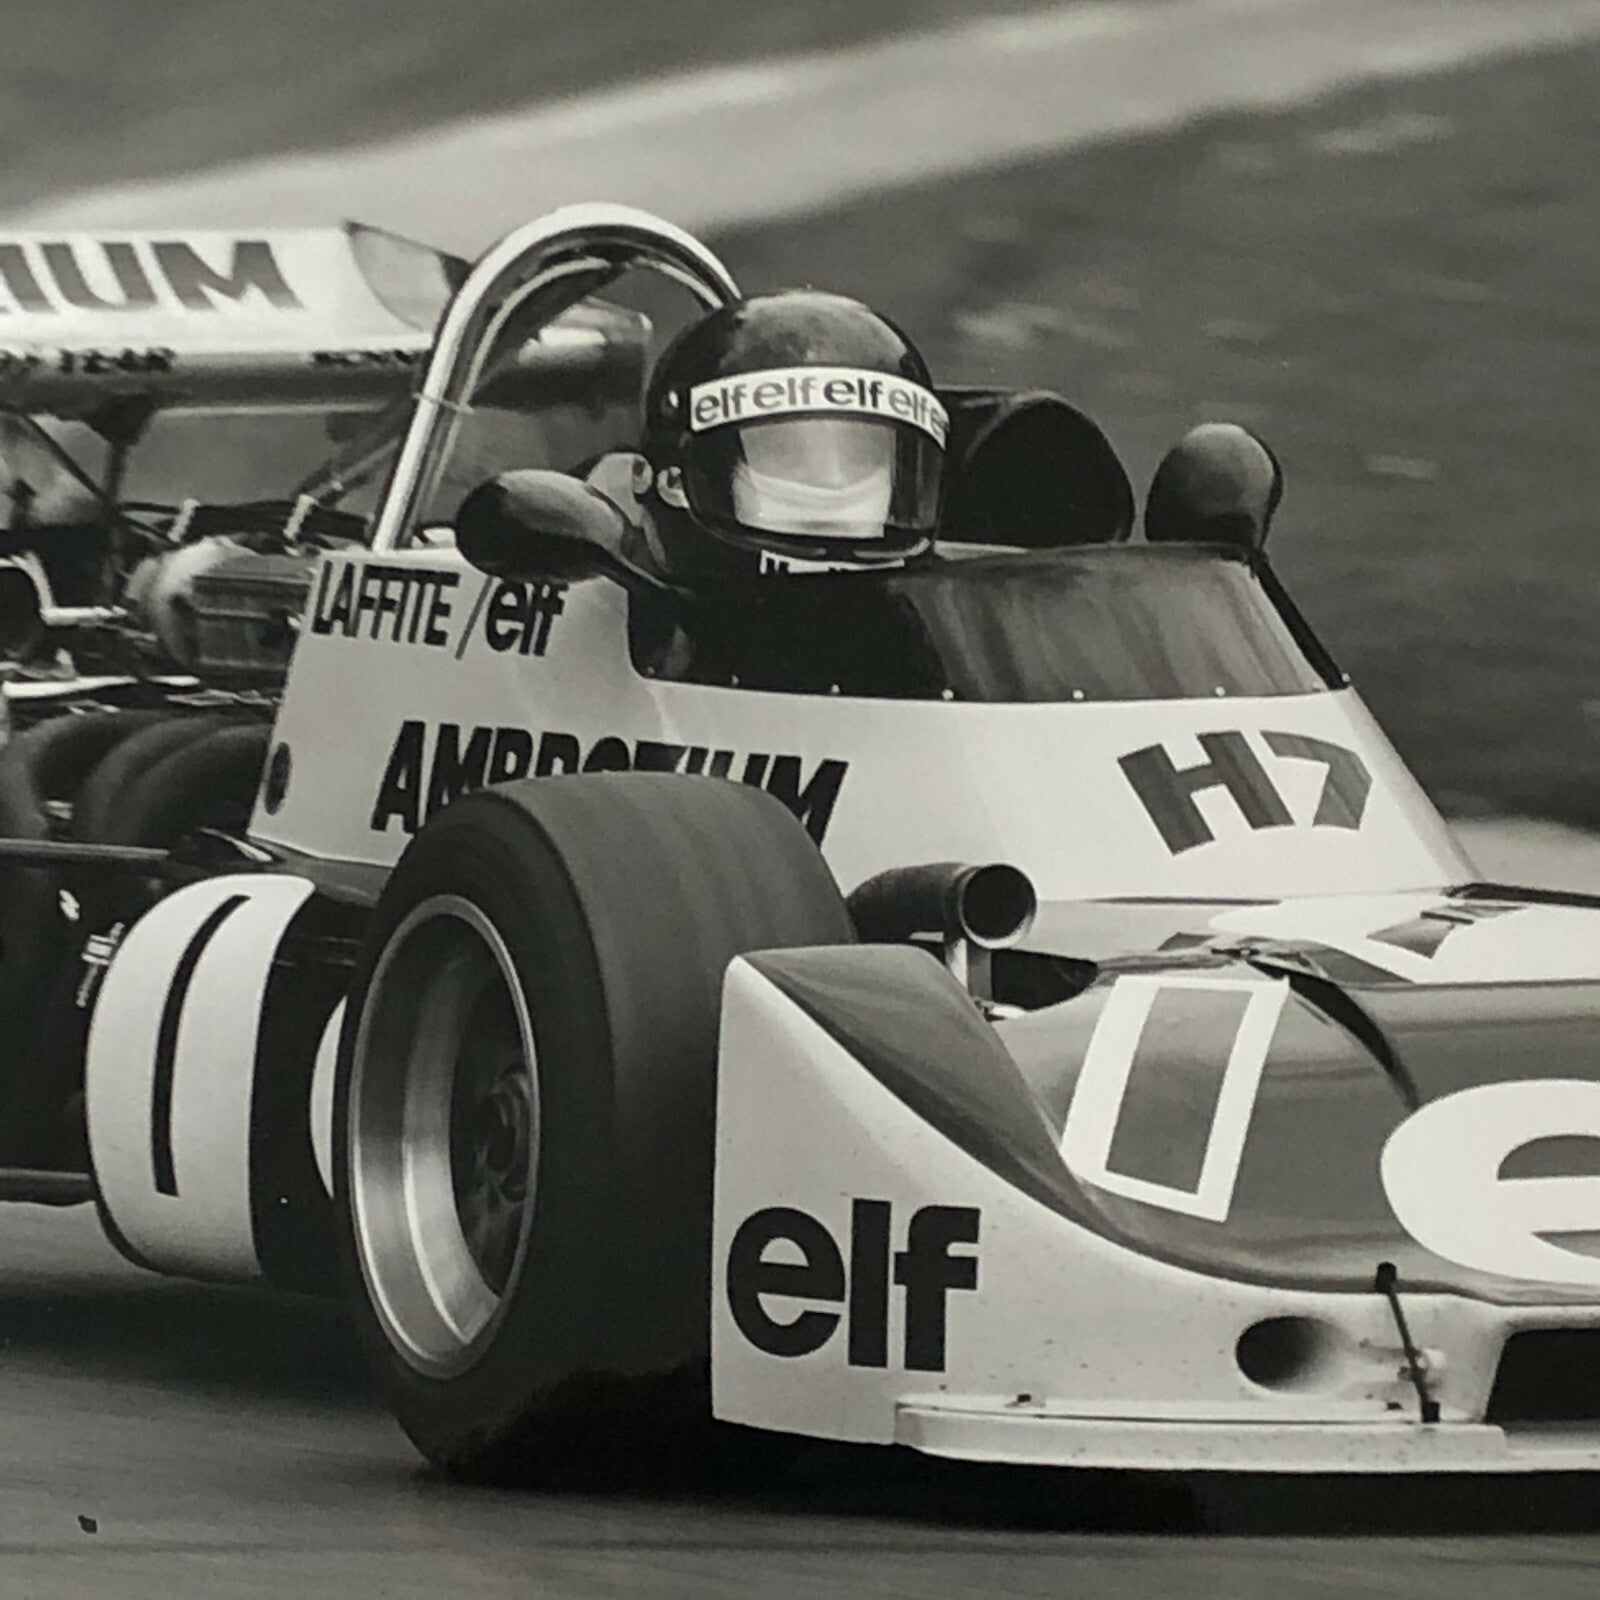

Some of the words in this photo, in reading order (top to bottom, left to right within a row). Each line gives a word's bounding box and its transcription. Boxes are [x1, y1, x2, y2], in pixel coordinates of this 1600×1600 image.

[0, 241, 304, 314] IUM
[311, 559, 461, 647] LAFFITE
[726, 1198, 981, 1372] elf
